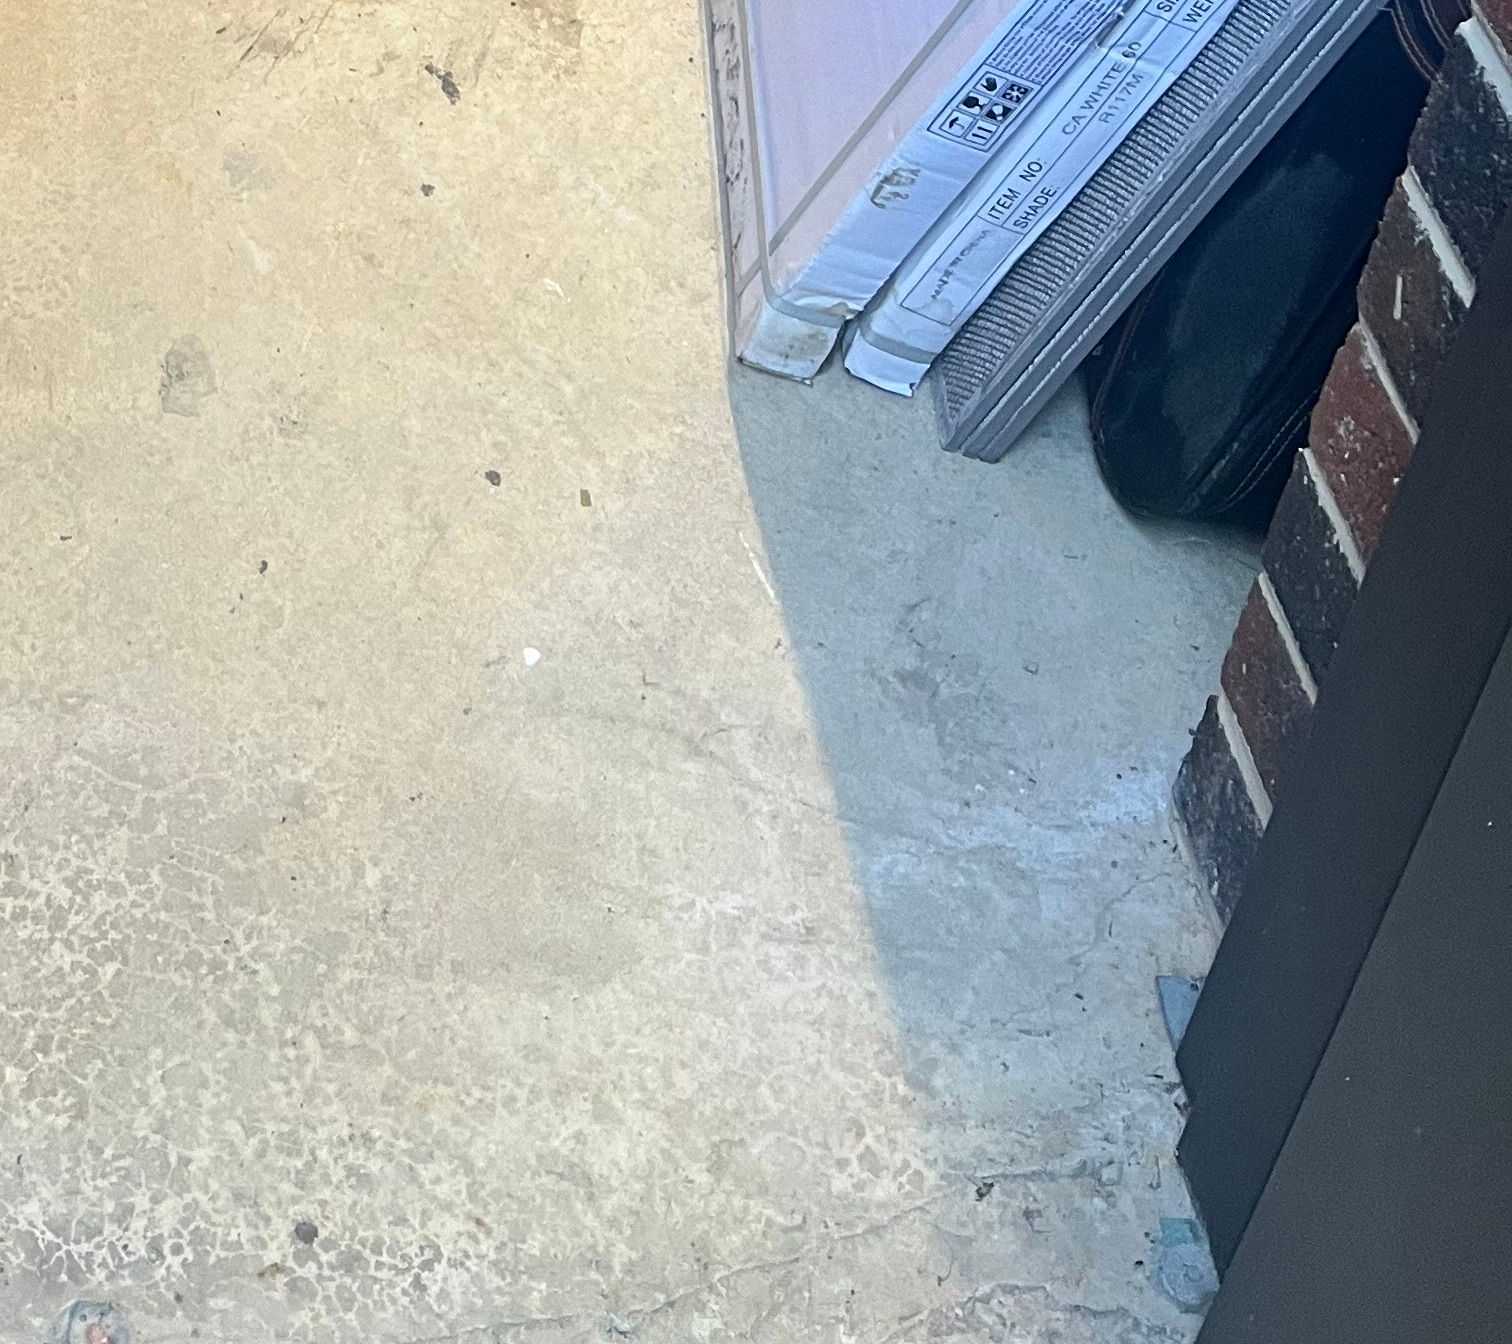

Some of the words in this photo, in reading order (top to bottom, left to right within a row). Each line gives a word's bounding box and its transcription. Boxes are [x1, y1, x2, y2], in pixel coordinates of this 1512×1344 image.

[987, 187, 1021, 220] ITEM
[1062, 111, 1084, 135] CA
[1080, 62, 1125, 113] WHITE
[1121, 41, 1142, 59] 60
